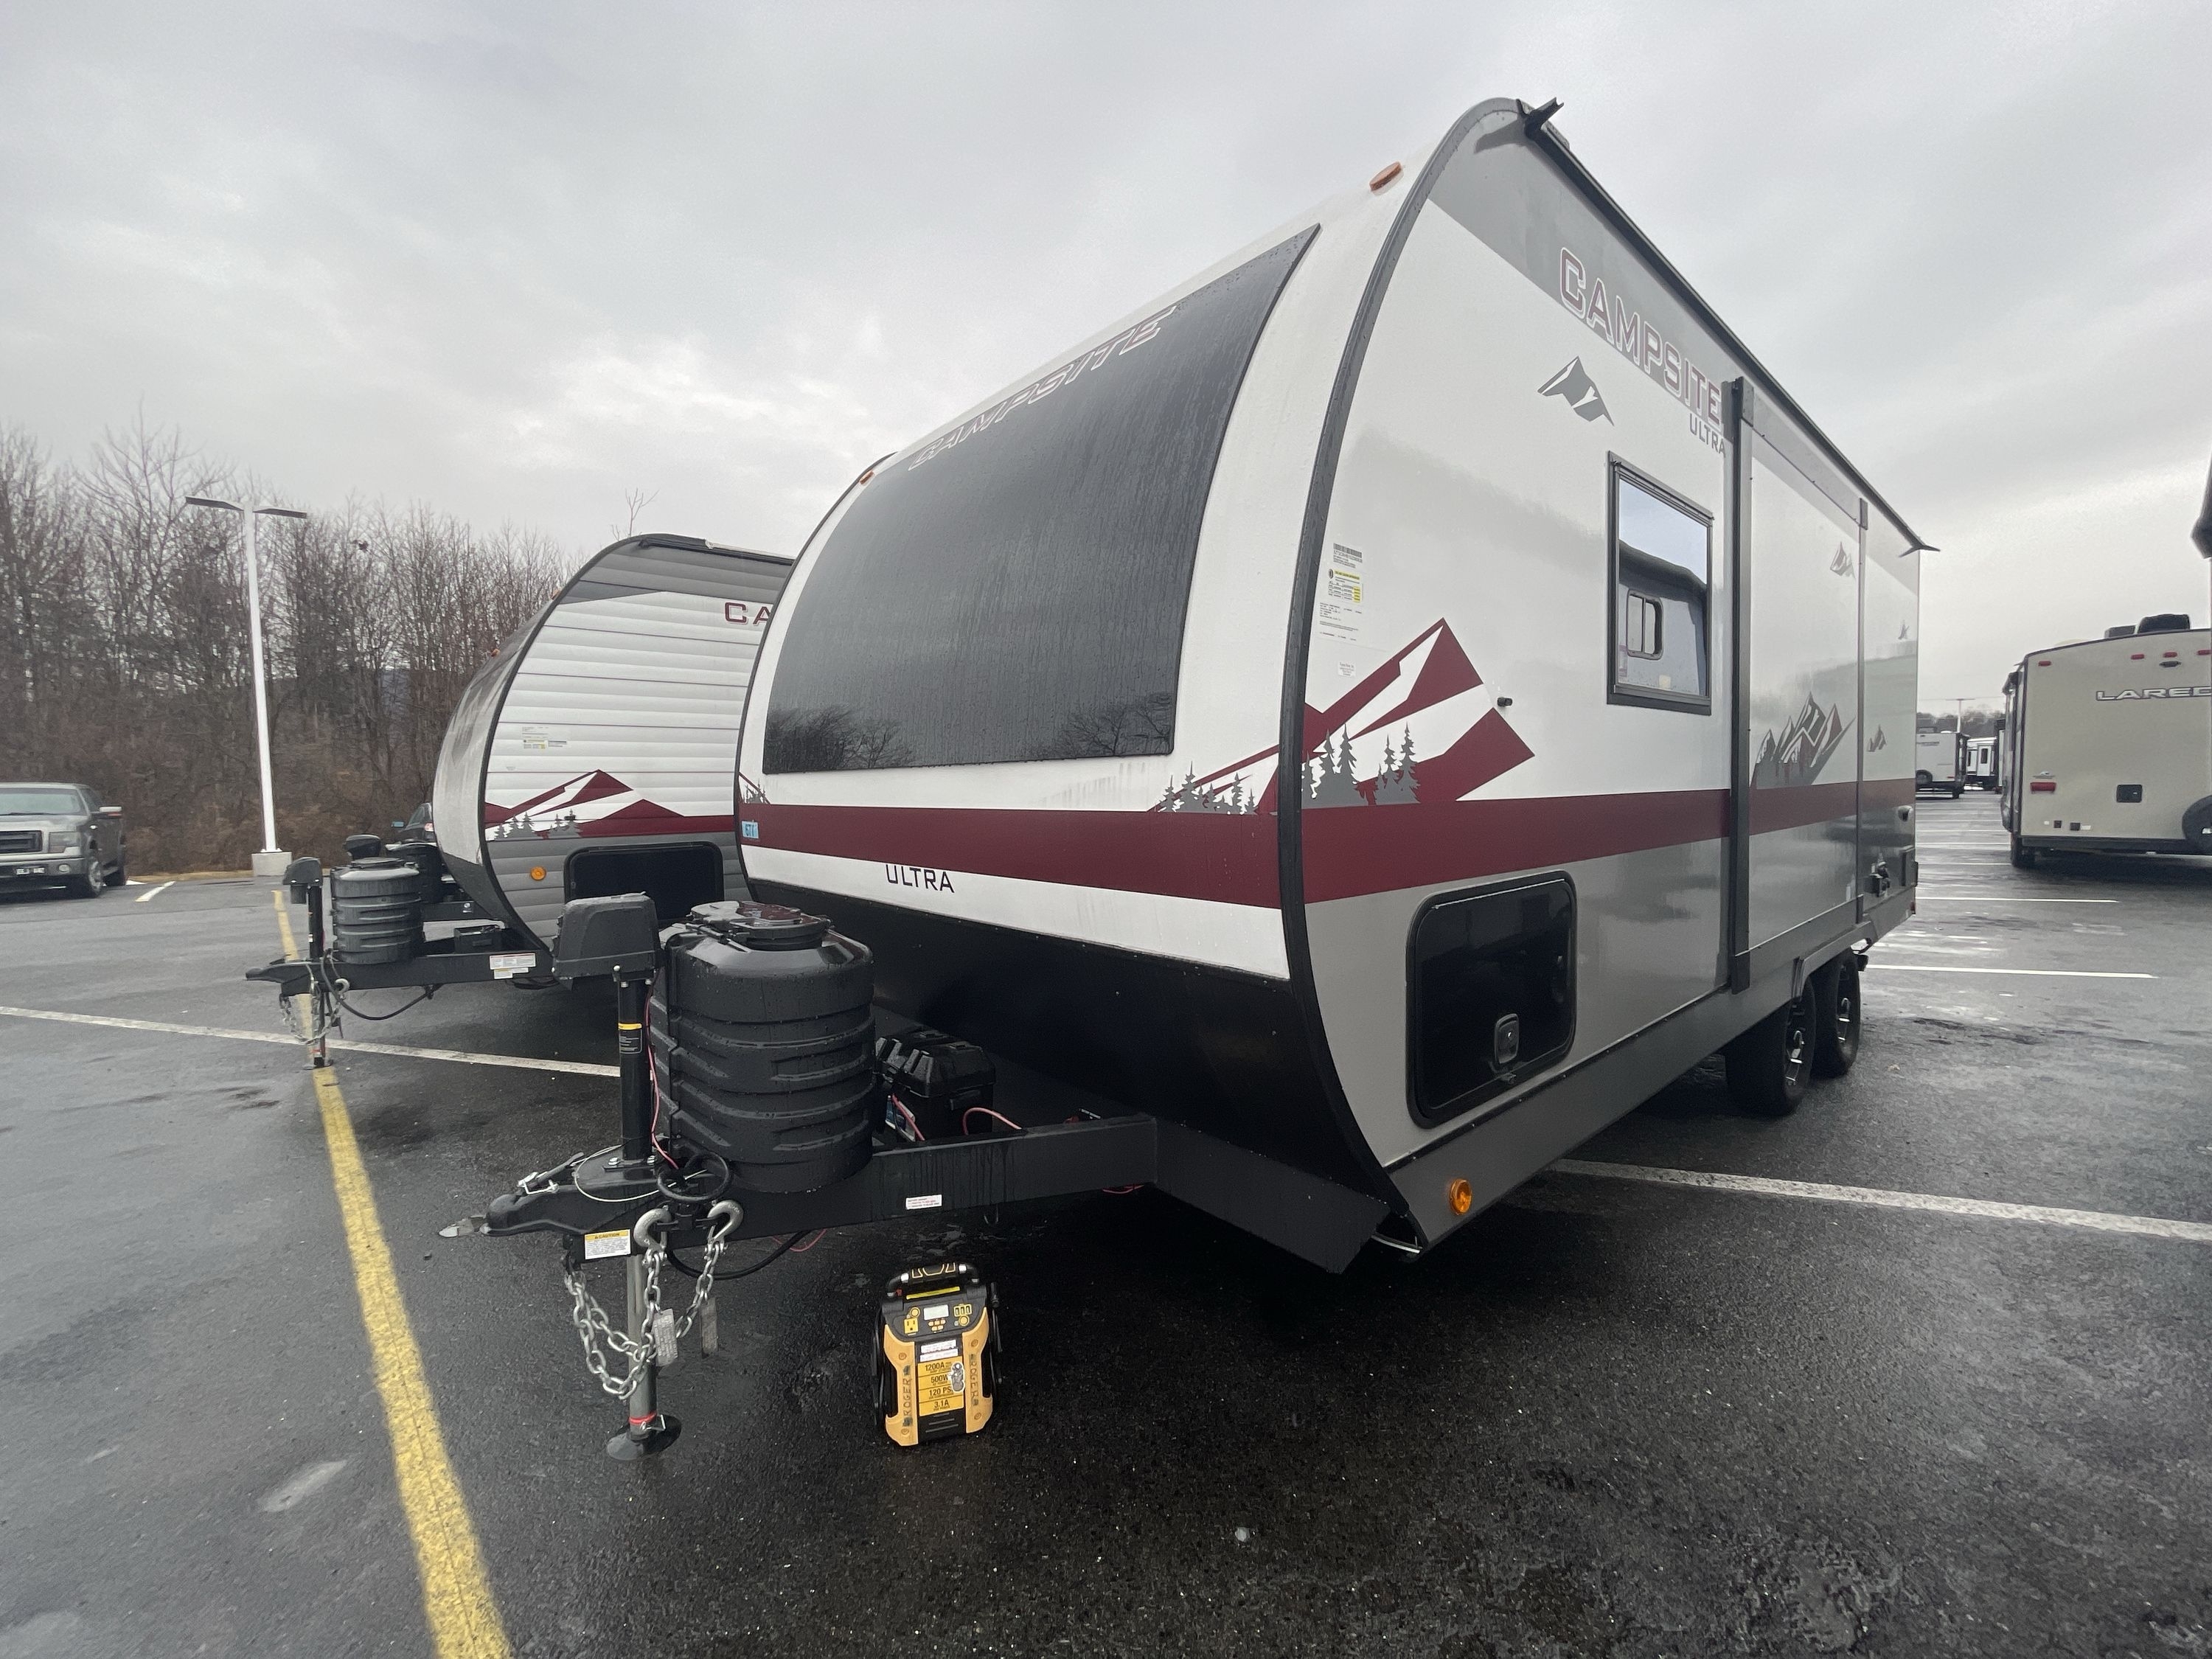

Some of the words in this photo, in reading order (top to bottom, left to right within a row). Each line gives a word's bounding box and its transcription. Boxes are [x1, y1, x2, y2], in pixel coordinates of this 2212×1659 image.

[1559, 247, 1722, 433] CAMPSITE
[1689, 412, 1726, 459] ULTRA
[886, 863, 956, 894] ULTRA
[925, 1362, 945, 1371] 1200A
[931, 1374, 949, 1383] 500W
[902, 1378, 912, 1416] ROGER
[929, 1388, 941, 1397] 120
[934, 1399, 949, 1408] 3.1A
